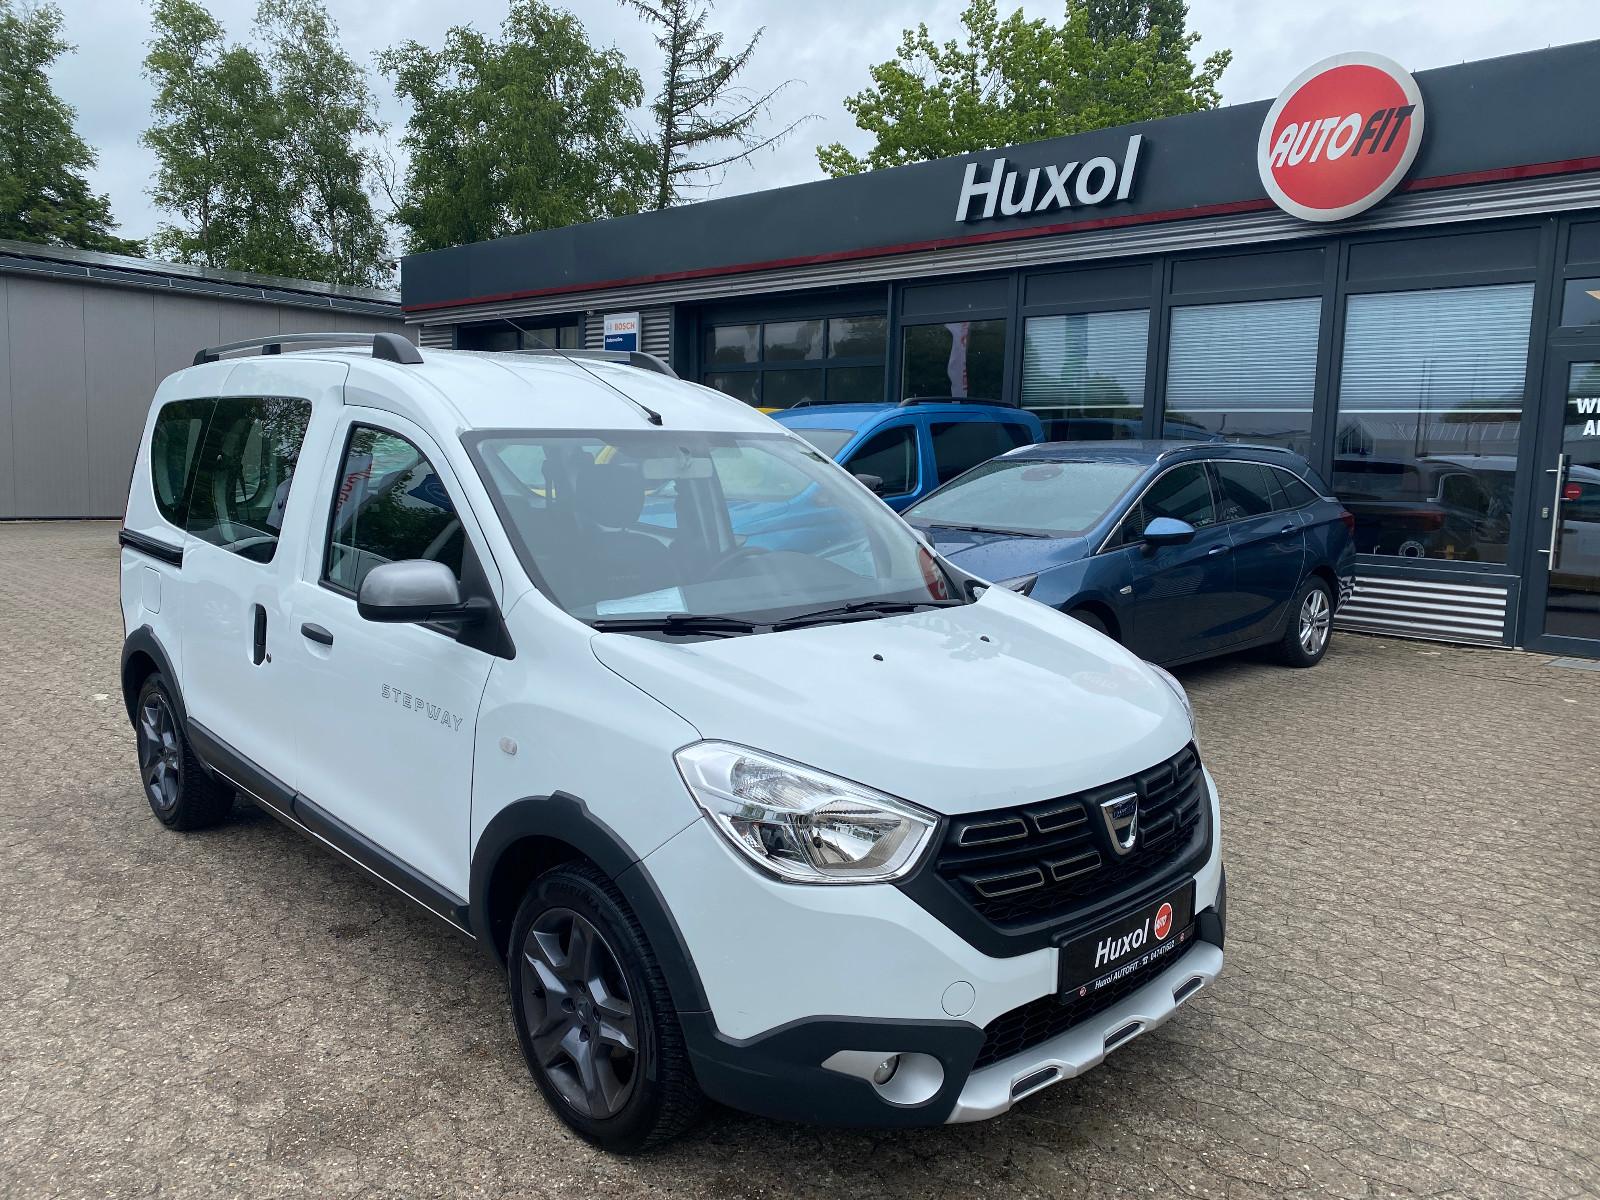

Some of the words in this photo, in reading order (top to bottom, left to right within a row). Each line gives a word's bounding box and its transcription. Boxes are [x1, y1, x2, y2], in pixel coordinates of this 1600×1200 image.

[1270, 104, 1415, 169] AUTOFIT
[955, 134, 1142, 223] Huxol
[614, 321, 635, 331] BOSCH
[381, 683, 463, 732] STEPWAY
[1094, 917, 1150, 968] Huxol
